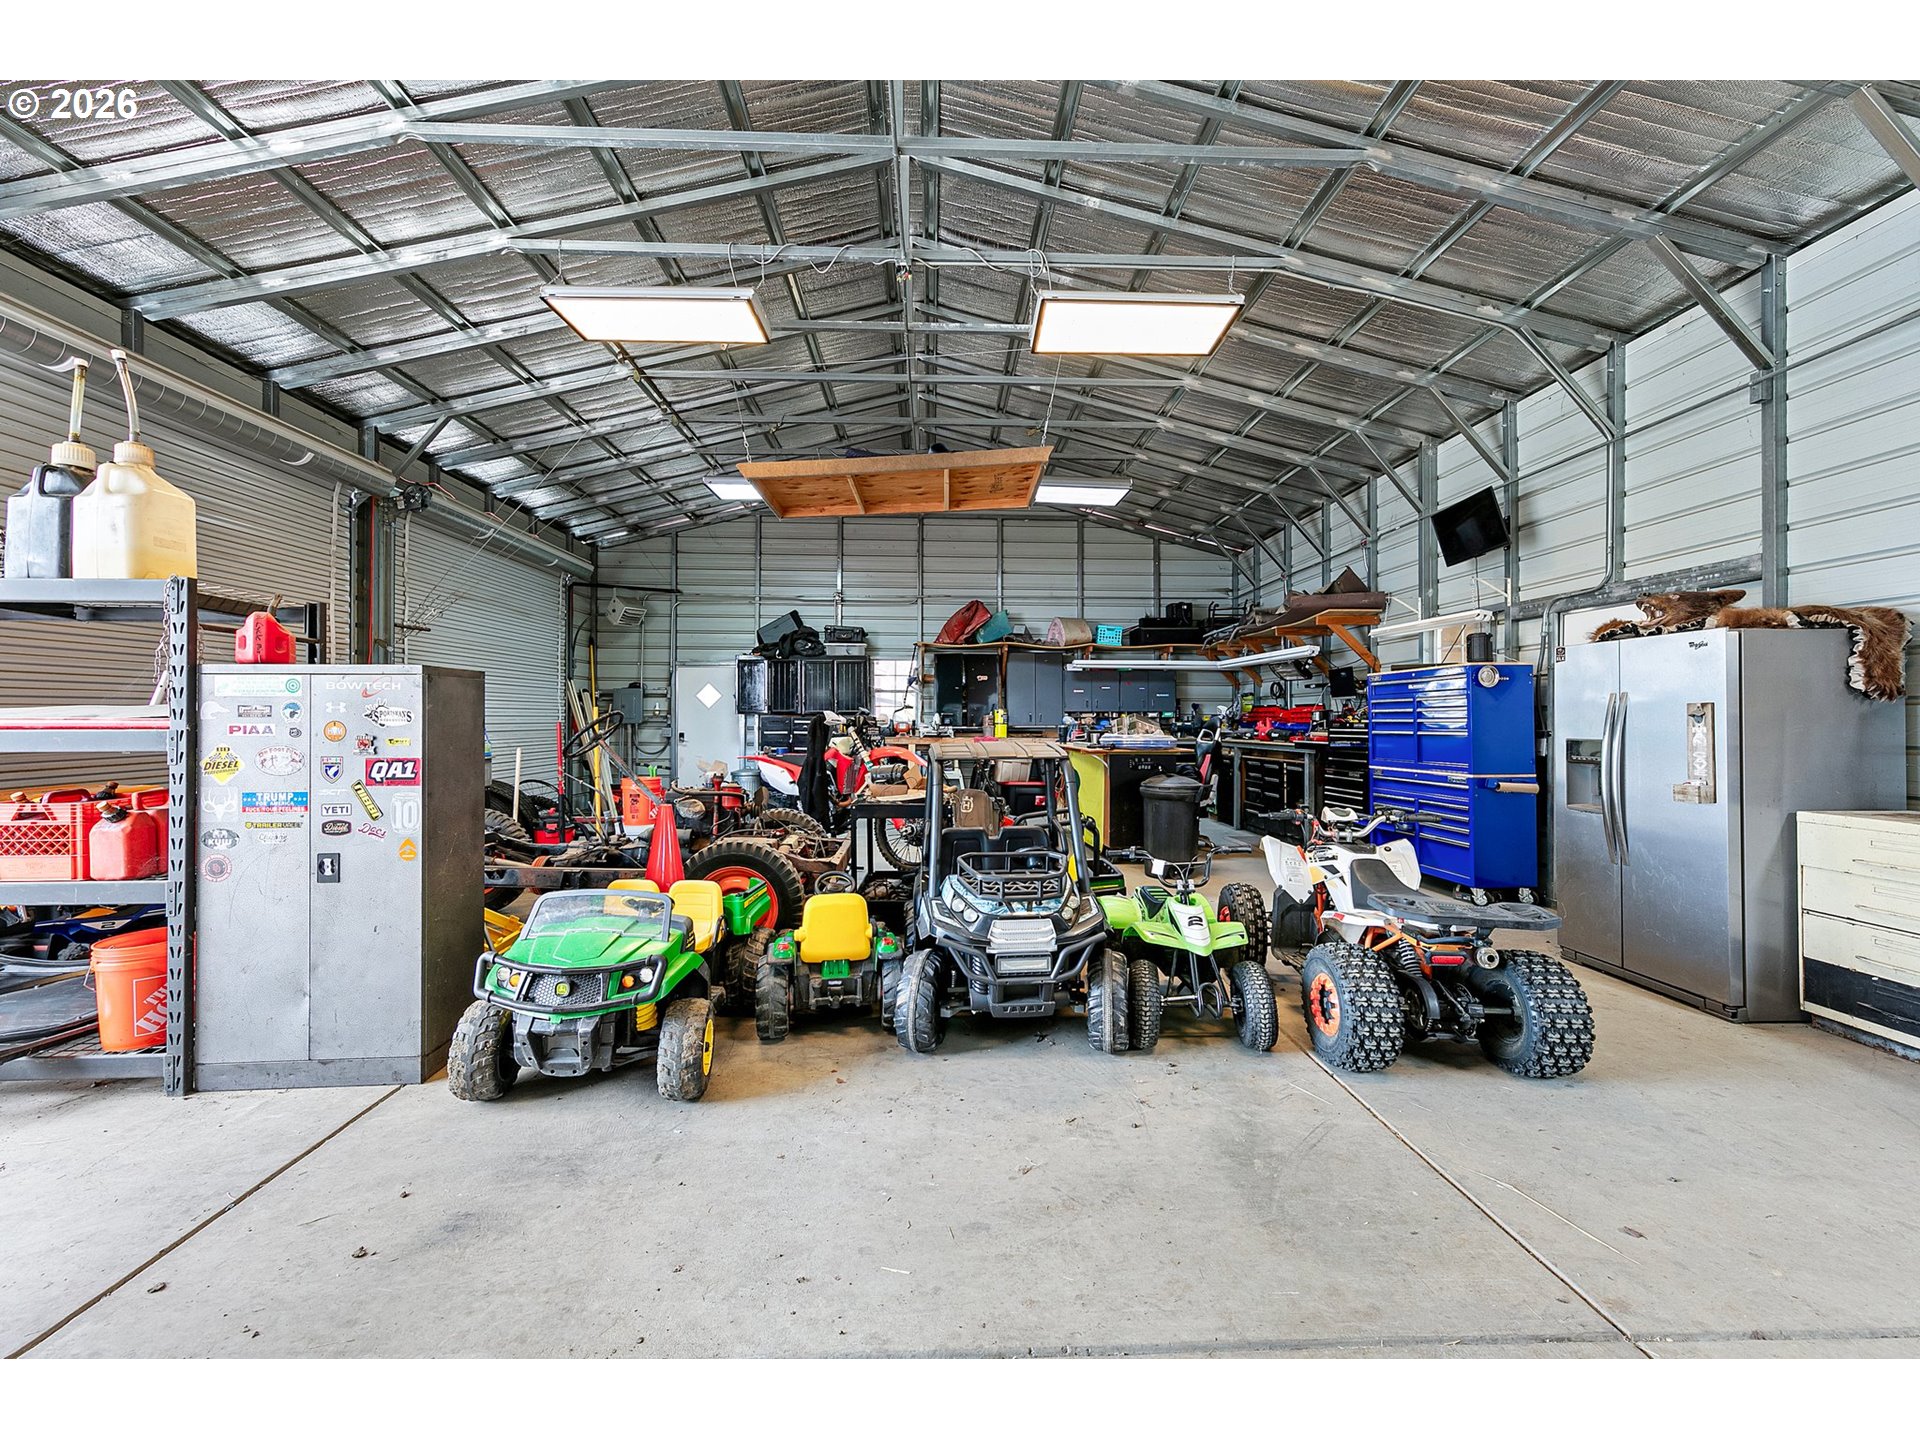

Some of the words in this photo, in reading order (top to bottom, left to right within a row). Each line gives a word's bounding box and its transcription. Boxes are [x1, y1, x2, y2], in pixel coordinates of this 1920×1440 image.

[326, 681, 401, 690] BOWTECH
[228, 725, 274, 735] PIAA
[203, 760, 239, 771] DIESEL
[370, 760, 416, 783] QA1
[255, 792, 294, 802] TRUMP
[323, 806, 349, 814] YETI
[100, 921, 116, 929] 2
[1187, 915, 1204, 927] 2
